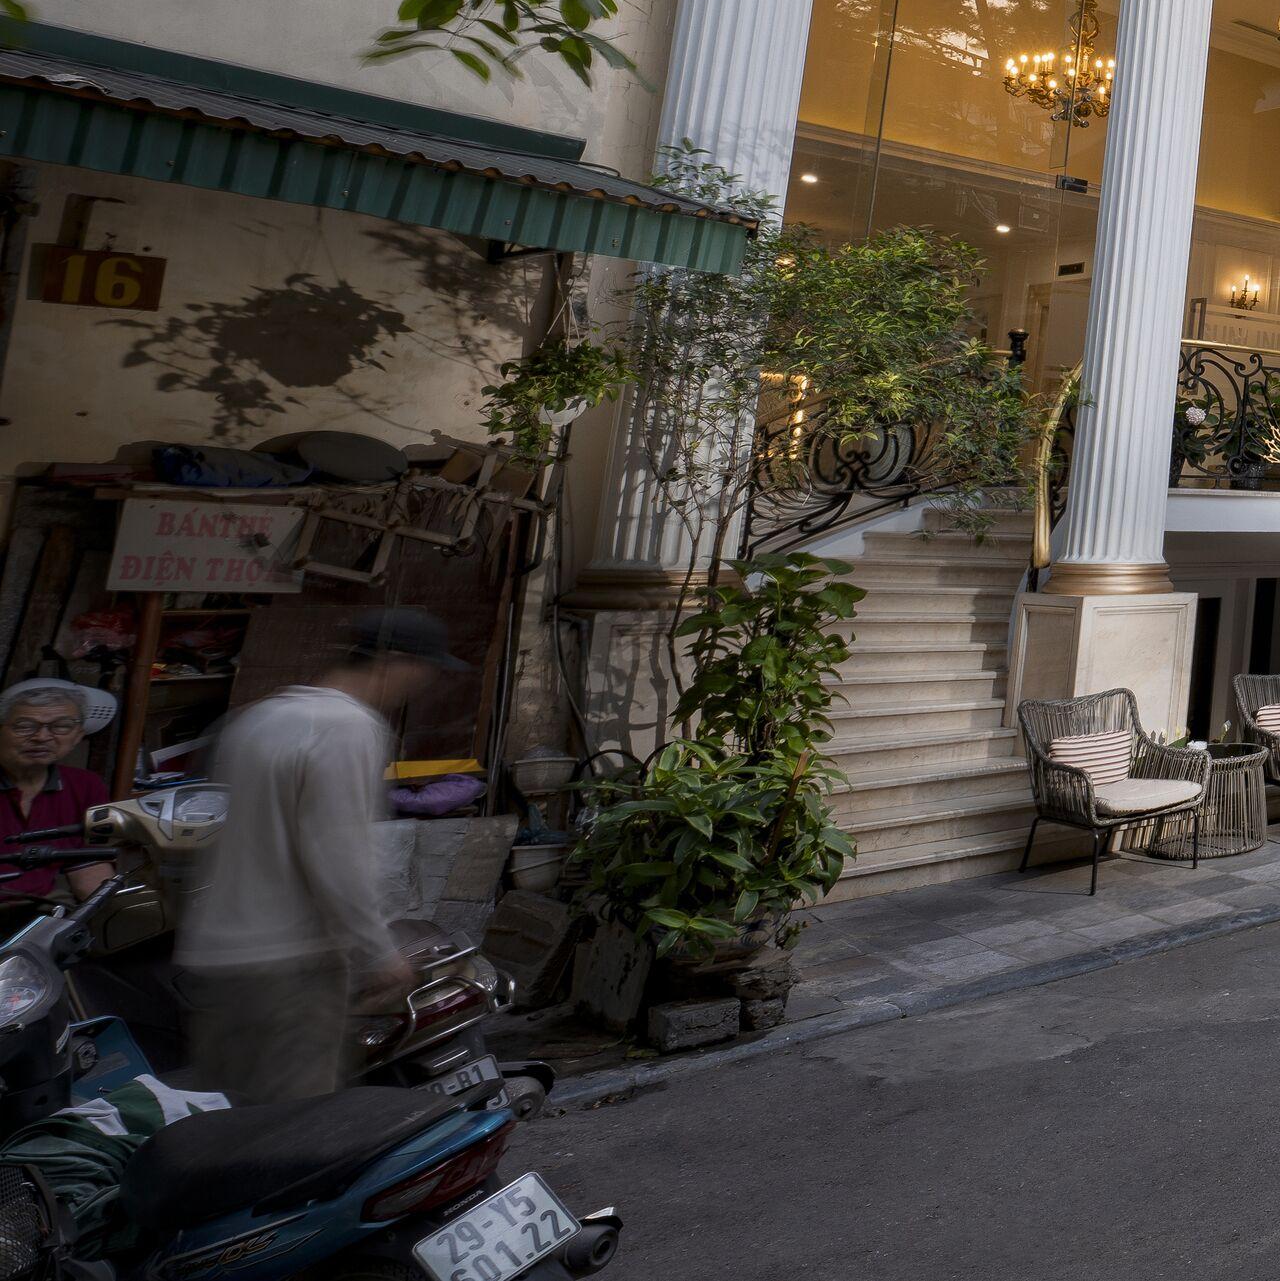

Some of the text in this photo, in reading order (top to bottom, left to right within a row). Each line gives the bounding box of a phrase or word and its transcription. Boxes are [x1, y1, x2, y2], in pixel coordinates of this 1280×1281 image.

[60, 254, 142, 307] 16
[155, 507, 214, 537] BÁN
[119, 550, 197, 586] ĐIỆN
[437, 1187, 537, 1266] 29-Y5
